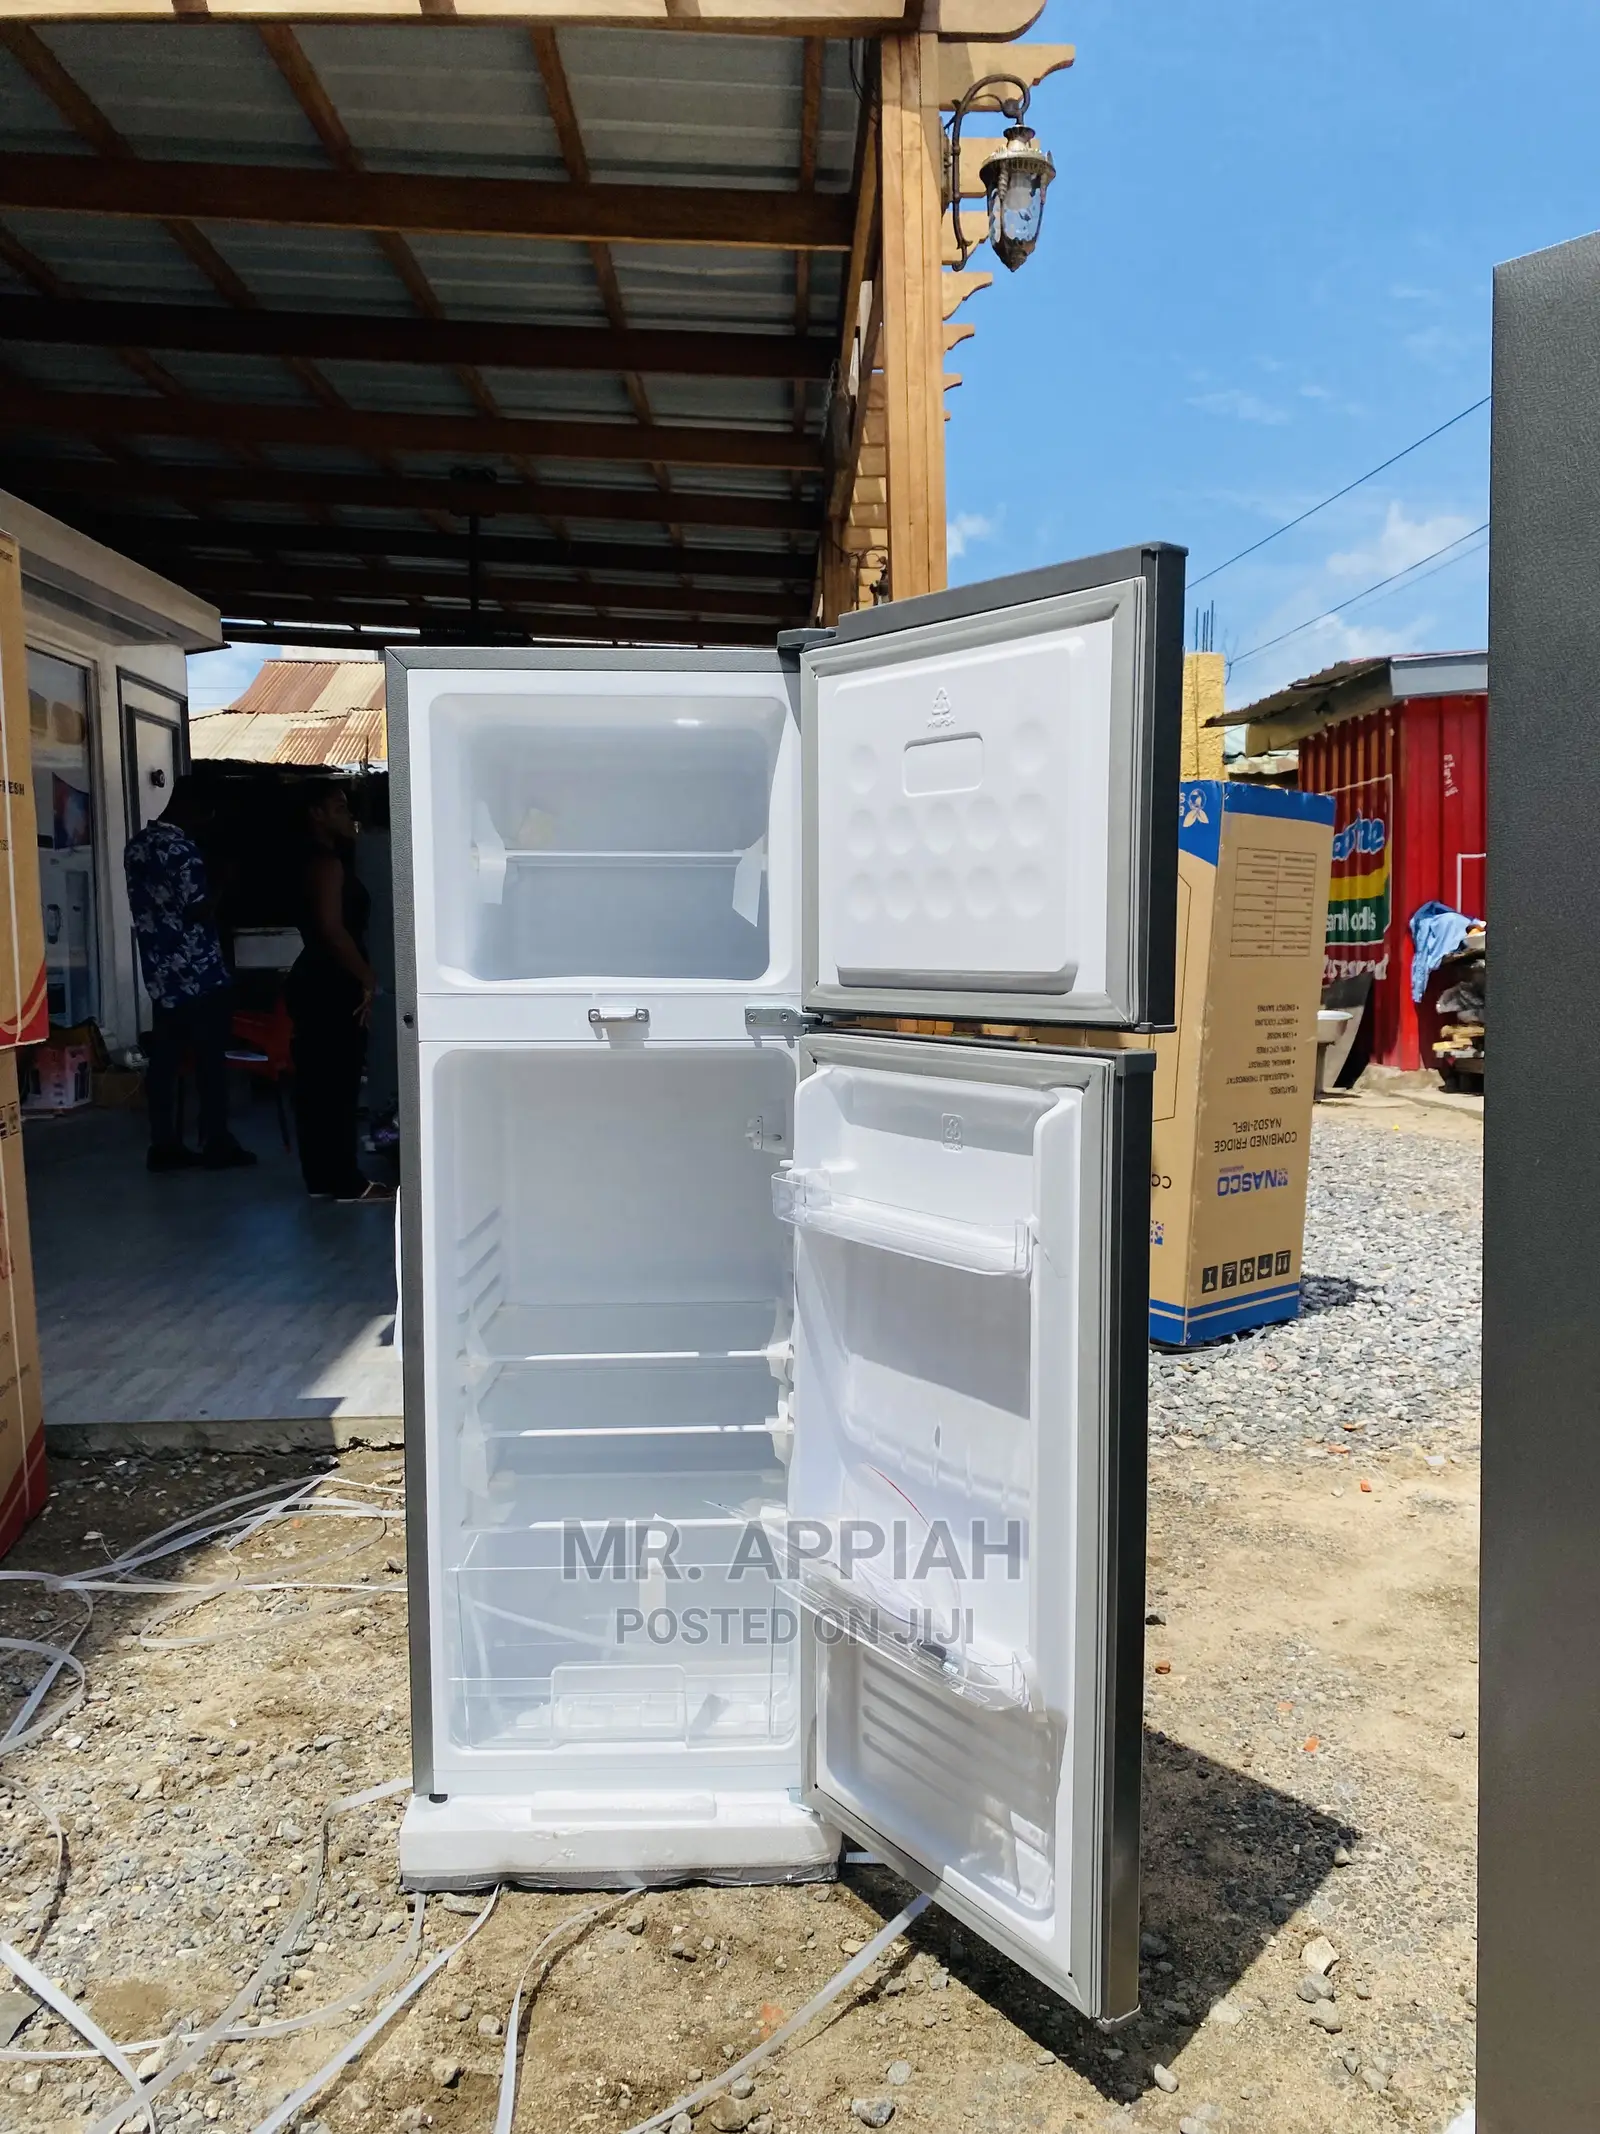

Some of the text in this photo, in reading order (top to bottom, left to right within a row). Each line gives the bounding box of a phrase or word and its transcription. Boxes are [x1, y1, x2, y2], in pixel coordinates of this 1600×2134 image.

[1213, 1131, 1298, 1153] COMBINED FRIDGE
[1217, 1168, 1278, 1197] NASCO
